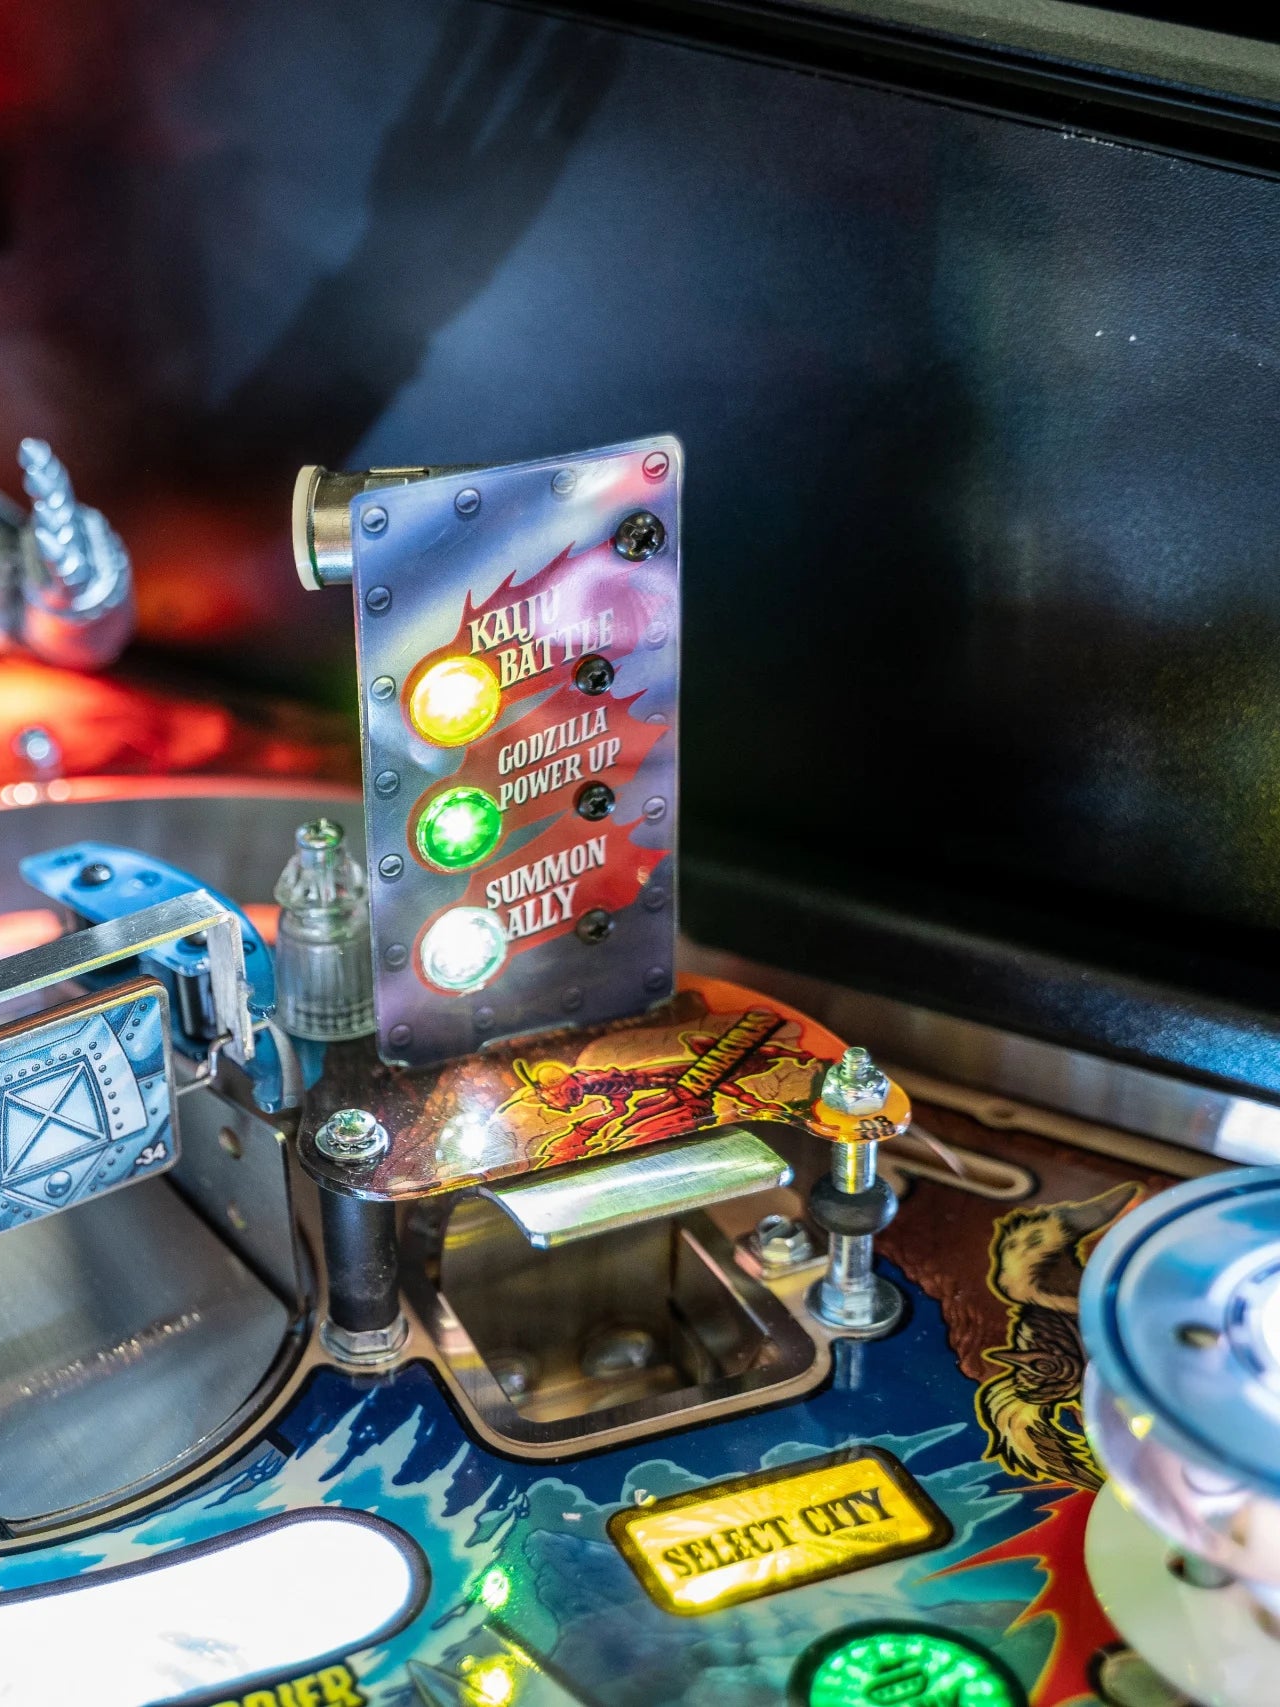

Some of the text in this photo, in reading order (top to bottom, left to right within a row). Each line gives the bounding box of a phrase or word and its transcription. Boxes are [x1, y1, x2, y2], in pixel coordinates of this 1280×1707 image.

[467, 586, 561, 655] KAIJU
[497, 608, 614, 689] BATTLE
[498, 706, 608, 775] GODZILLA
[499, 737, 620, 812] POWER UP
[486, 834, 608, 910] SUMMON
[506, 881, 579, 943] ALLY
[135, 1142, 166, 1165] -34
[663, 1487, 895, 1577] SELECT CITY
